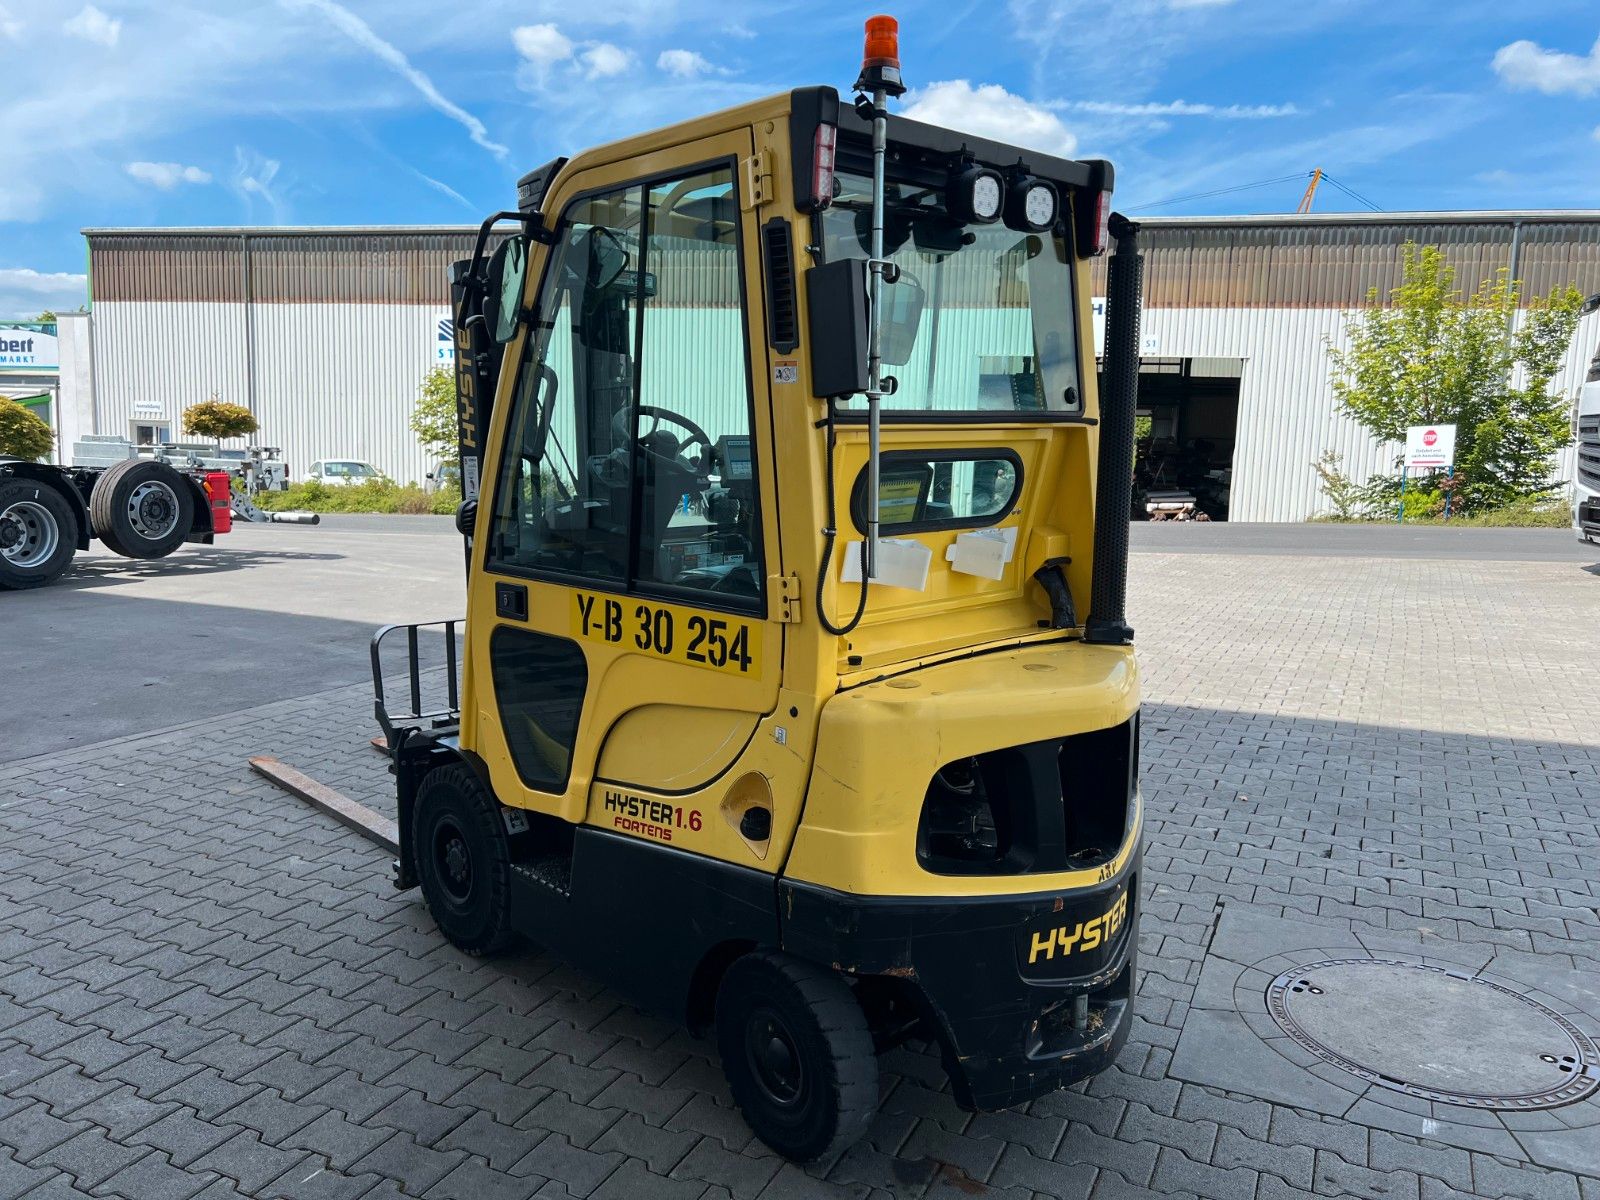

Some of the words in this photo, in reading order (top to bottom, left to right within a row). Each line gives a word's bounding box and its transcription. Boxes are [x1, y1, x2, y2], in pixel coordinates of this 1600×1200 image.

[458, 328, 476, 448] HYSTE
[1424, 434, 1437, 442] STOP
[577, 593, 623, 643] Y-B
[634, 605, 674, 655] 30
[686, 615, 752, 672] 254
[605, 791, 673, 825] HYSTER
[675, 807, 702, 832] 1.6
[614, 816, 672, 841] FORTENS
[1028, 890, 1127, 964] HYSTER
